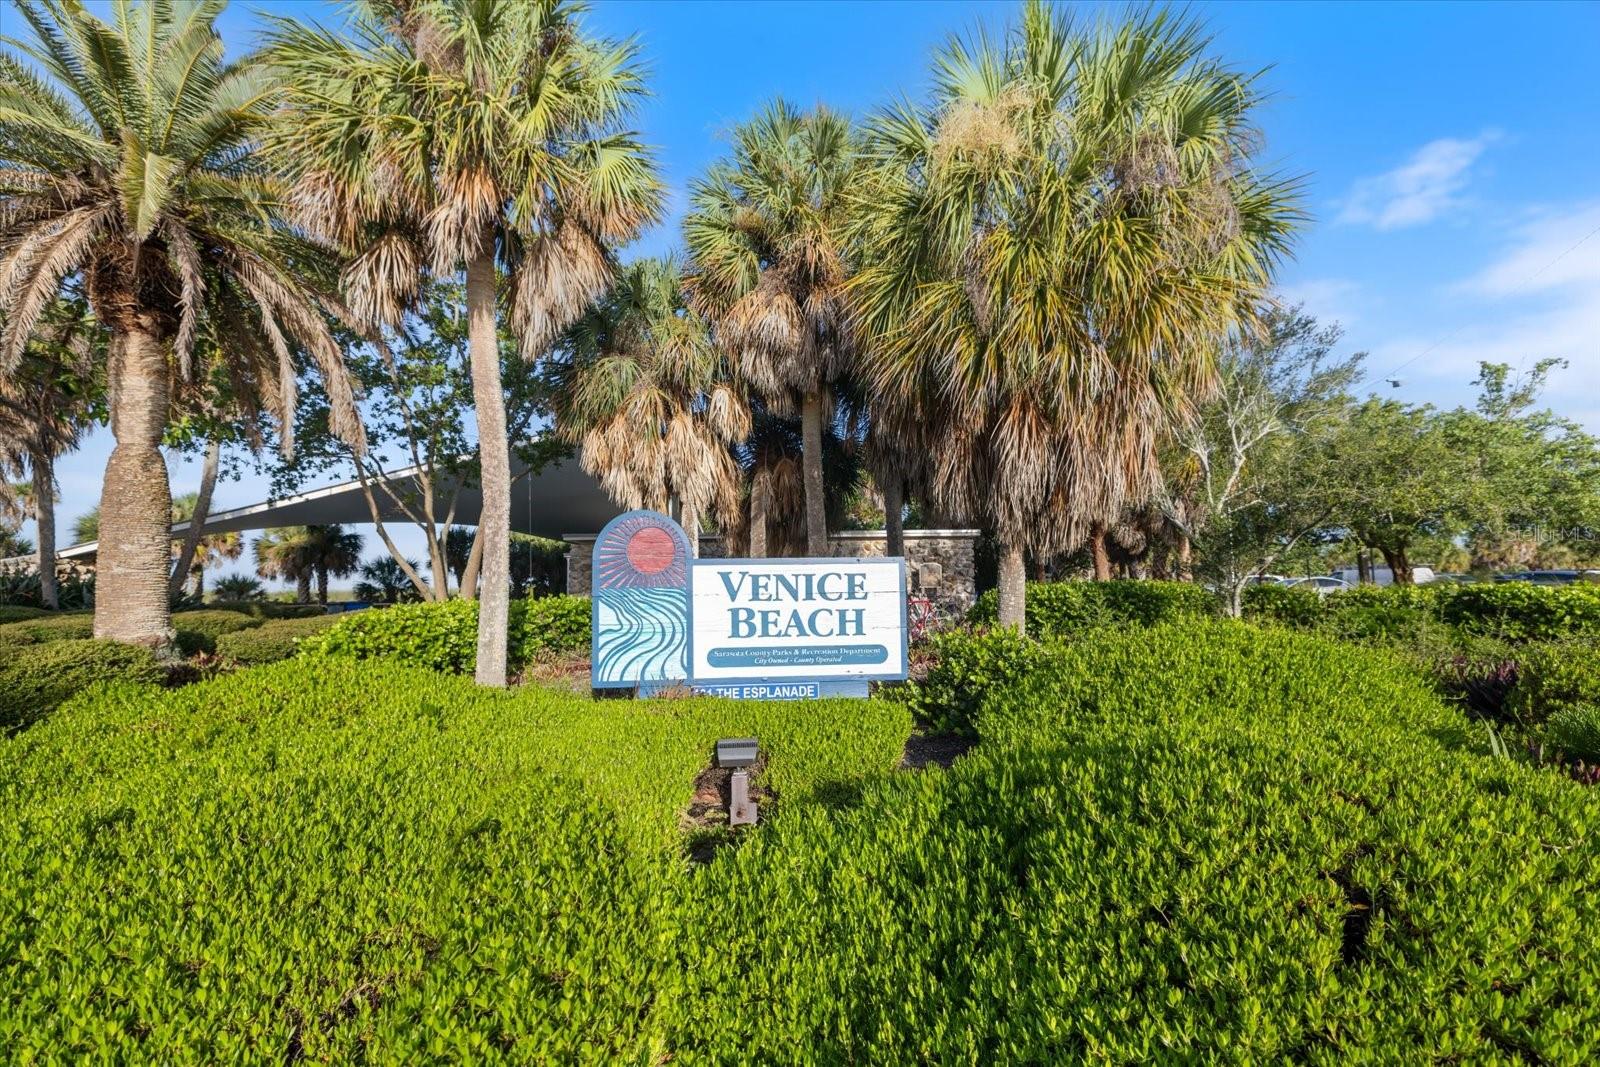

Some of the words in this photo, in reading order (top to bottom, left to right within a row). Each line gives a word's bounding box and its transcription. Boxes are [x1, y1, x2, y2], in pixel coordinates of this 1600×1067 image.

[717, 571, 868, 603] VENICE
[727, 607, 867, 639] BEACH
[745, 650, 770, 658] County
[839, 647, 881, 656] Department
[754, 657, 767, 665] City
[793, 656, 814, 664] County
[815, 655, 843, 665] Operated
[716, 687, 740, 699] THE
[743, 685, 815, 699] ESPLANADE
